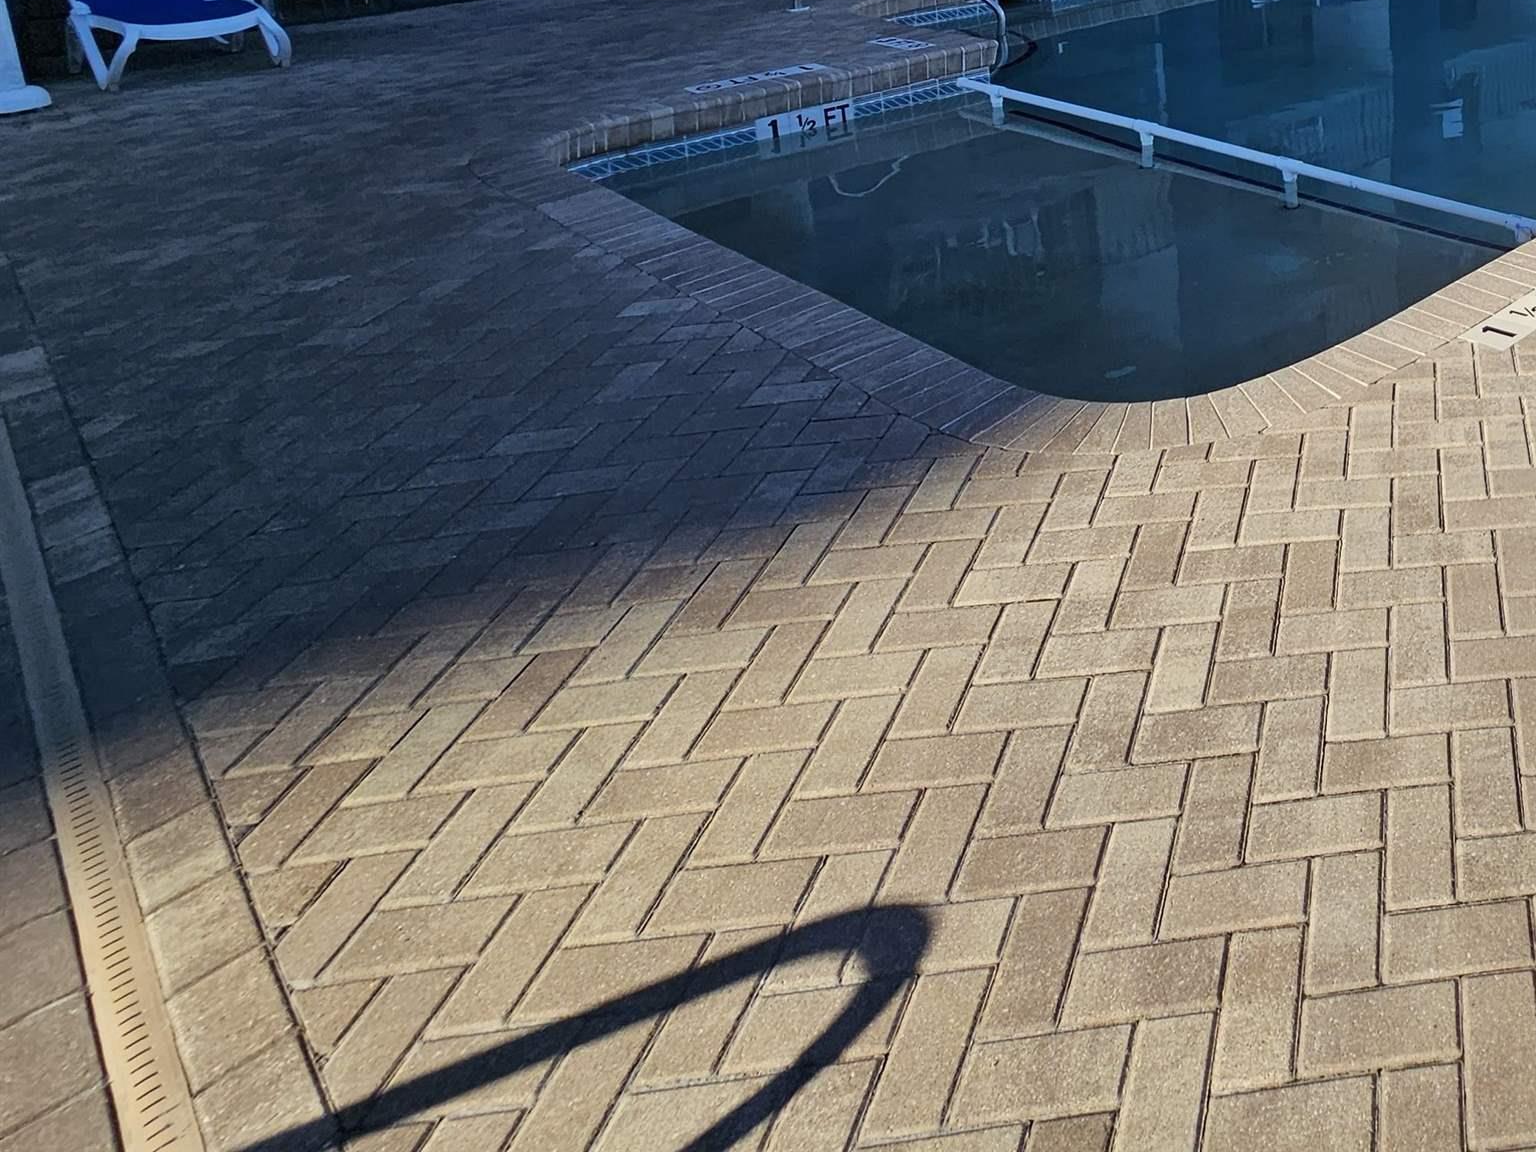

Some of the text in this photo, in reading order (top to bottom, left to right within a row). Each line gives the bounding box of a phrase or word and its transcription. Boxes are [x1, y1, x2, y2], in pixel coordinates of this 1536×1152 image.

[767, 119, 779, 138] 1
[824, 103, 849, 128] FT
[1482, 326, 1517, 338] 1
